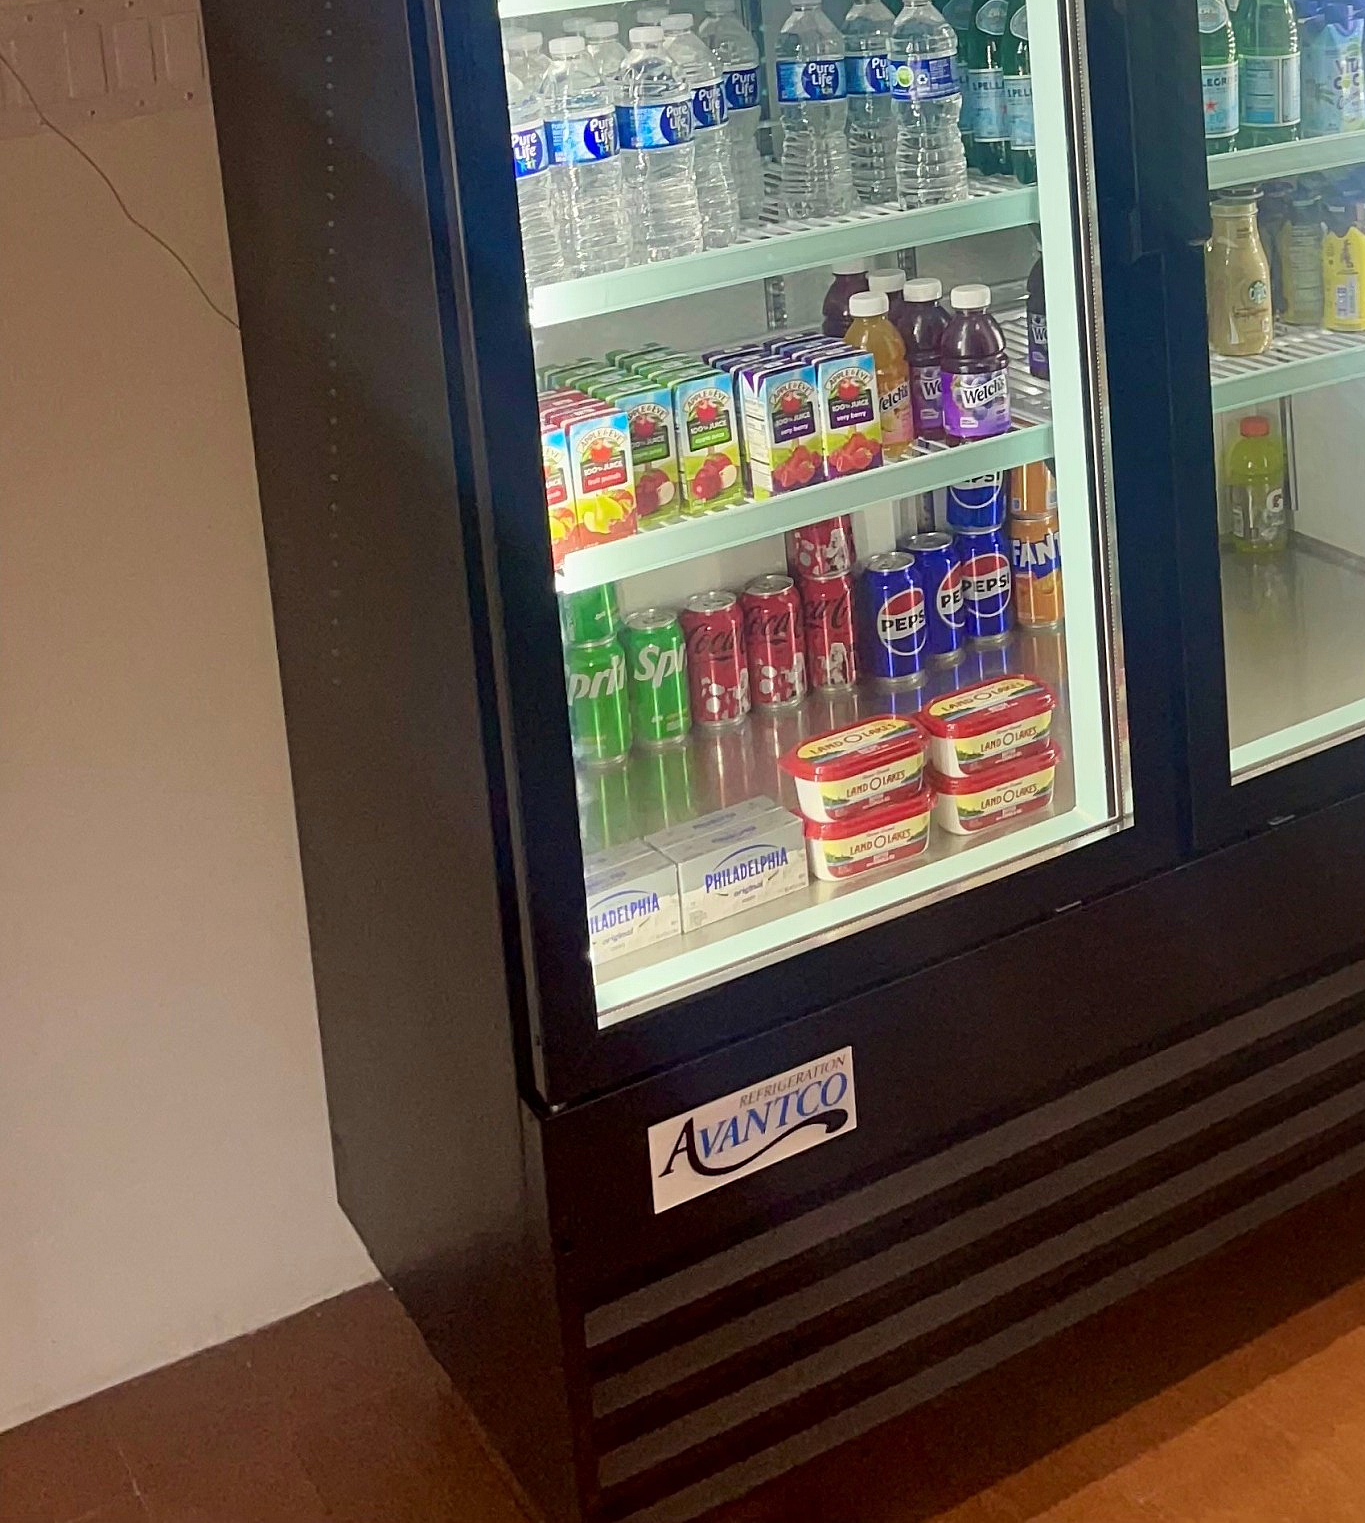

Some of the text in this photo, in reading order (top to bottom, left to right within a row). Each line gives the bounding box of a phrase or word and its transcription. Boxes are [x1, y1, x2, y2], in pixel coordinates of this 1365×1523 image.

[808, 62, 836, 76] Pure
[731, 73, 756, 87] Pure
[811, 73, 834, 88] Life
[698, 87, 722, 102] Pure
[735, 82, 755, 97] Life
[666, 104, 689, 119] Pure
[702, 98, 722, 115] Life
[589, 117, 615, 133] Pure
[669, 115, 688, 133] Life
[511, 131, 538, 148] Pure
[594, 128, 615, 144] Life
[515, 144, 538, 162] Life
[963, 377, 1006, 405] Welch's
[962, 572, 1010, 594] PEPSI
[981, 737, 1001, 753] LAND
[1016, 726, 1037, 742] LAKES
[846, 782, 868, 798] LAND
[882, 770, 906, 786] LAKES
[981, 795, 1002, 810] LAND
[1016, 784, 1037, 799] LAKES
[850, 839, 872, 855] LAND
[887, 828, 911, 844] LAKES
[705, 846, 788, 894] PHILADELPHIA
[739, 1054, 846, 1109] REFRIGERATION
[658, 1072, 848, 1178] AVANTCO
